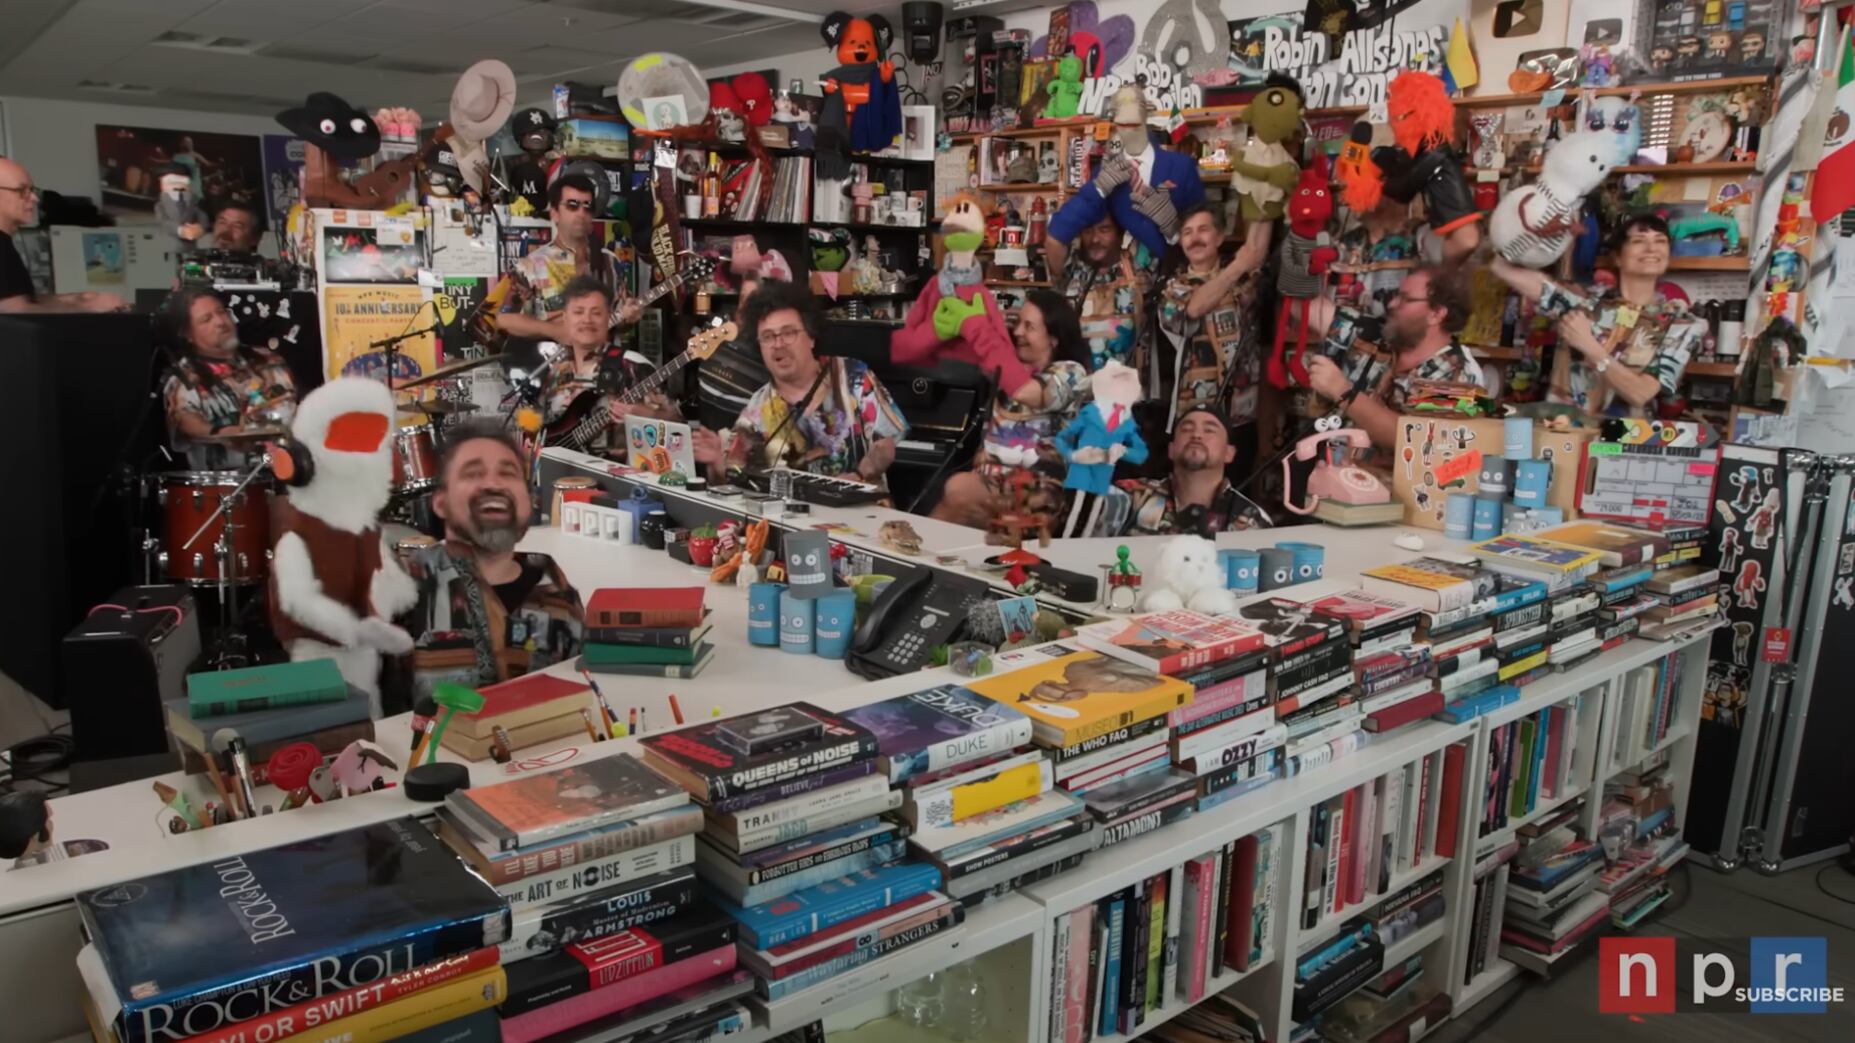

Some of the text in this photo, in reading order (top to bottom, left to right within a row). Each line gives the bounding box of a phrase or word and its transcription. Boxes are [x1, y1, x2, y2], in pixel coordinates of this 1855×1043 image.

[1262, 24, 1326, 71] Robin
[946, 734, 988, 759] DUKE
[1063, 728, 1129, 758] THE WHO FAQ
[1221, 739, 1257, 765] OZZY
[732, 756, 799, 786] QUEENS
[812, 741, 860, 763] NOISE
[780, 780, 810, 796] BELIEVE
[1103, 811, 1162, 846] ALTAMONT
[965, 852, 1009, 873] SHOW POSTERS
[528, 880, 553, 903] ART
[555, 878, 569, 889] OF
[572, 861, 621, 889] NOISE
[240, 892, 296, 945] ROCK
[607, 891, 652, 913] LOUIS
[582, 905, 677, 939] ARMSTRONG
[808, 920, 939, 980] Wayfaring STRANGERS
[142, 943, 417, 1043] ROCK & ROLL
[398, 968, 463, 995] TYLER CONROY
[304, 984, 385, 1027] SWIFT
